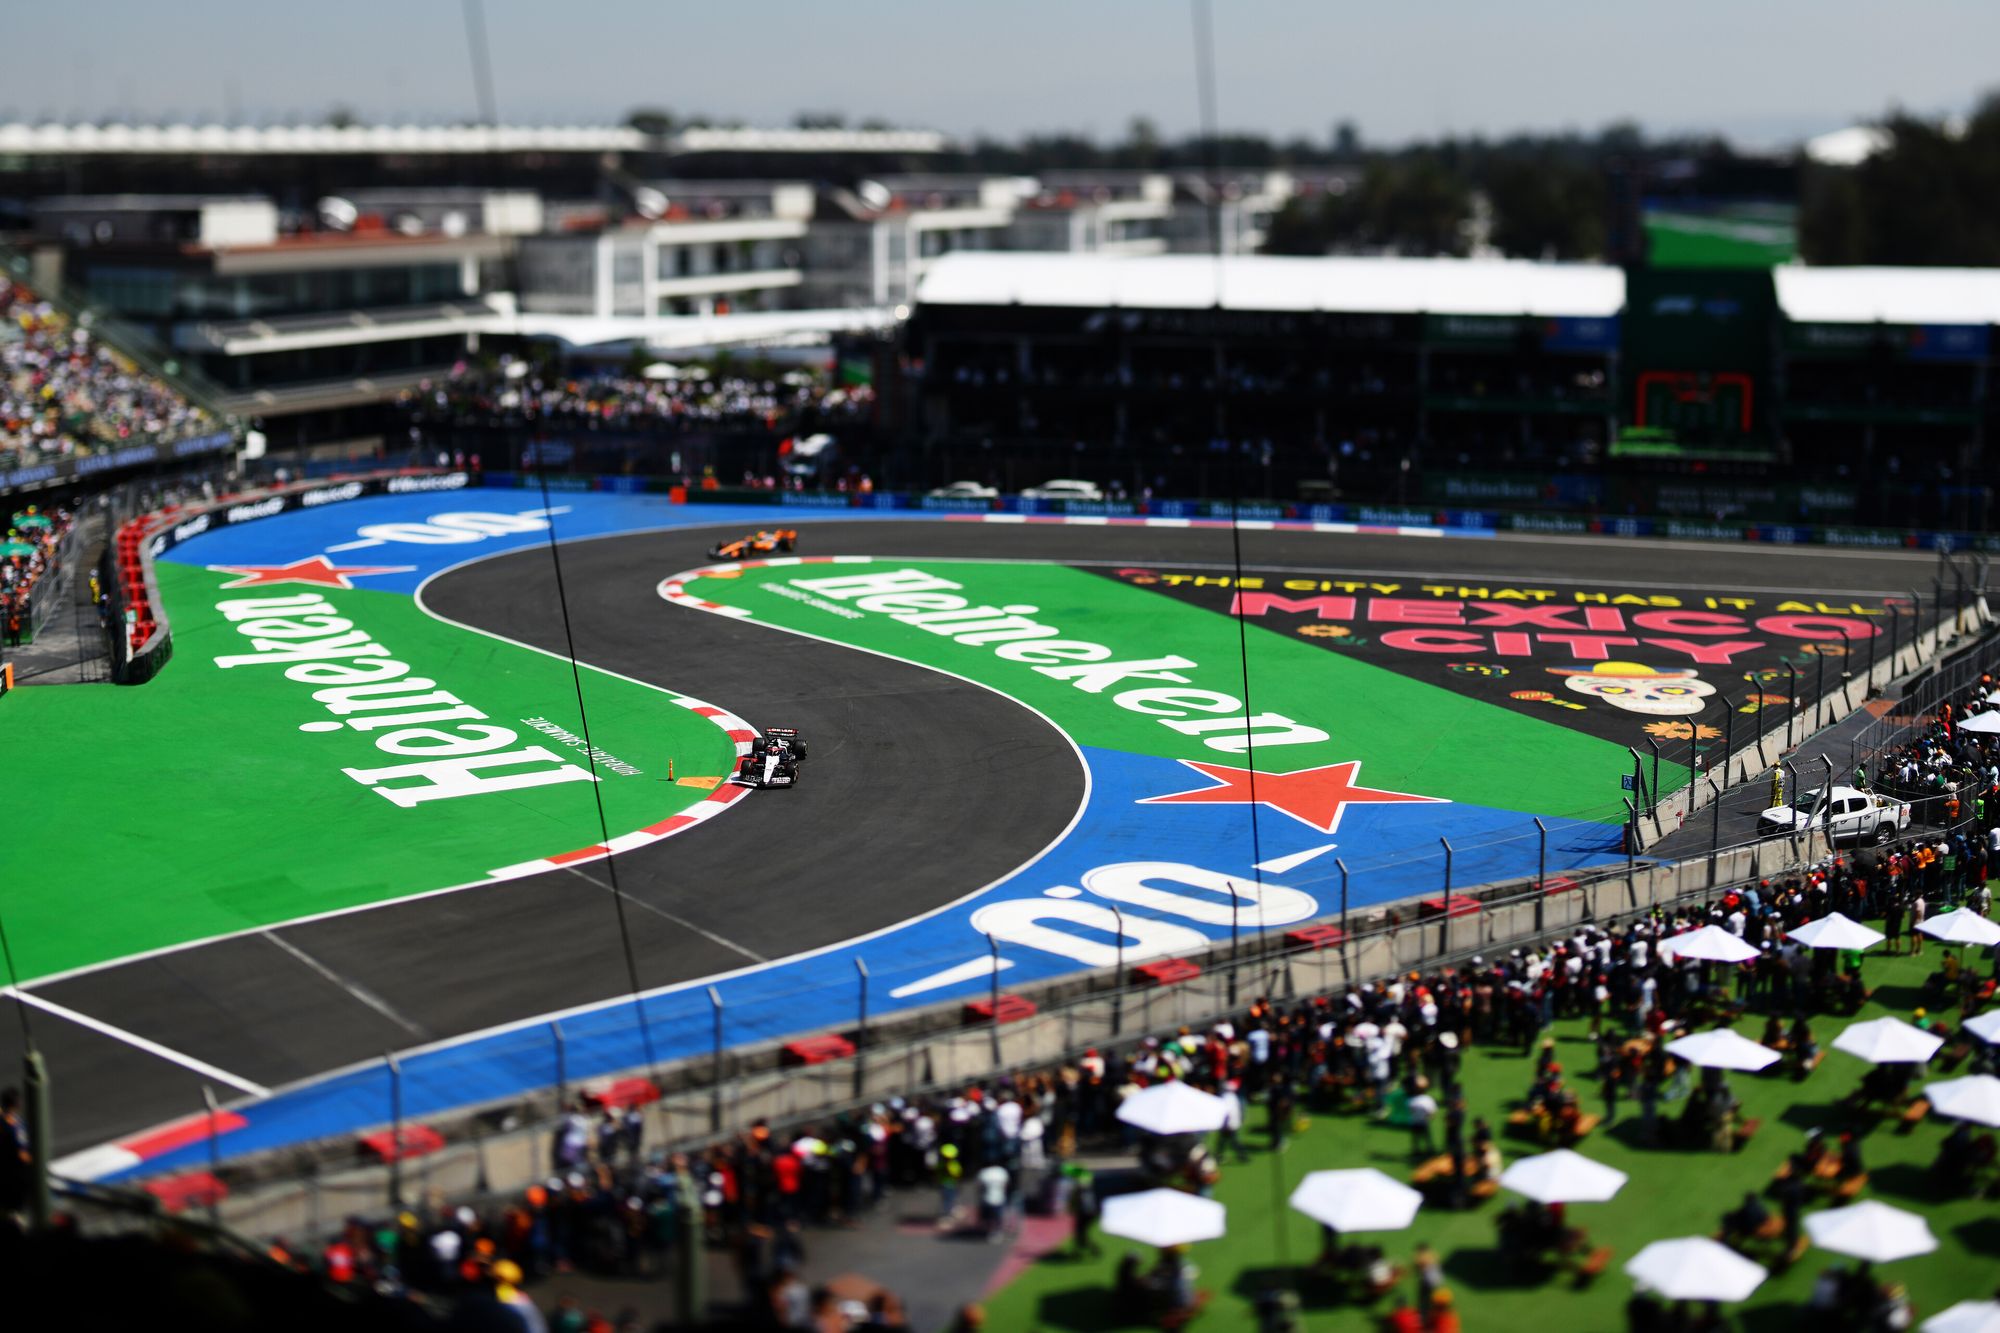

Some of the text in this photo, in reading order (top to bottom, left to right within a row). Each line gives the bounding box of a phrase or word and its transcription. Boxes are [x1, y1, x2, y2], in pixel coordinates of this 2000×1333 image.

[1162, 574, 1887, 615] THE CITY THAT HAS IT ALL
[1230, 592, 1884, 640] MEXICO
[789, 569, 1330, 753] Heineken
[1380, 629, 1766, 664] CITY
[213, 593, 603, 808] Heineken
